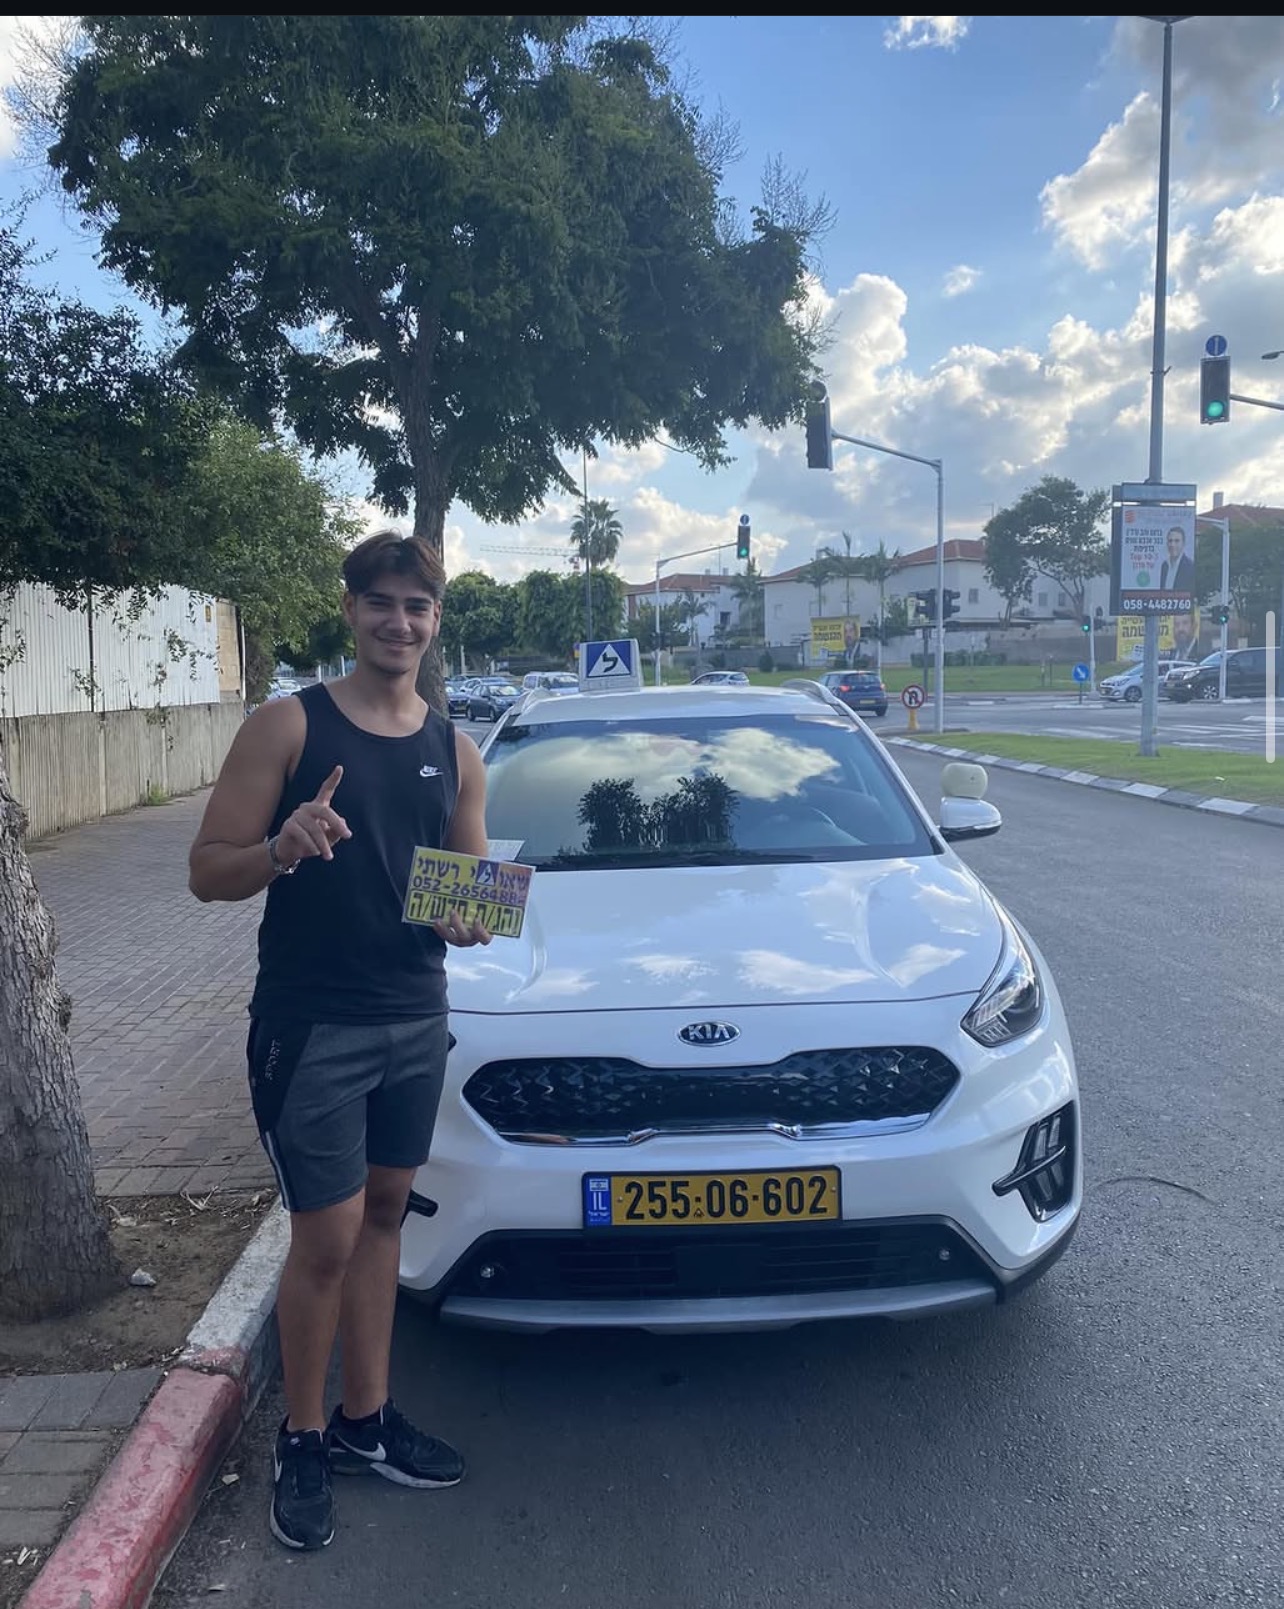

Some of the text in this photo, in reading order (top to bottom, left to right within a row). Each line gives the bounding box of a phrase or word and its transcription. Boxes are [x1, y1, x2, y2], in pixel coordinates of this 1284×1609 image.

[602, 652, 618, 673] ל
[688, 1024, 731, 1040] KIA
[593, 1191, 607, 1211] IL
